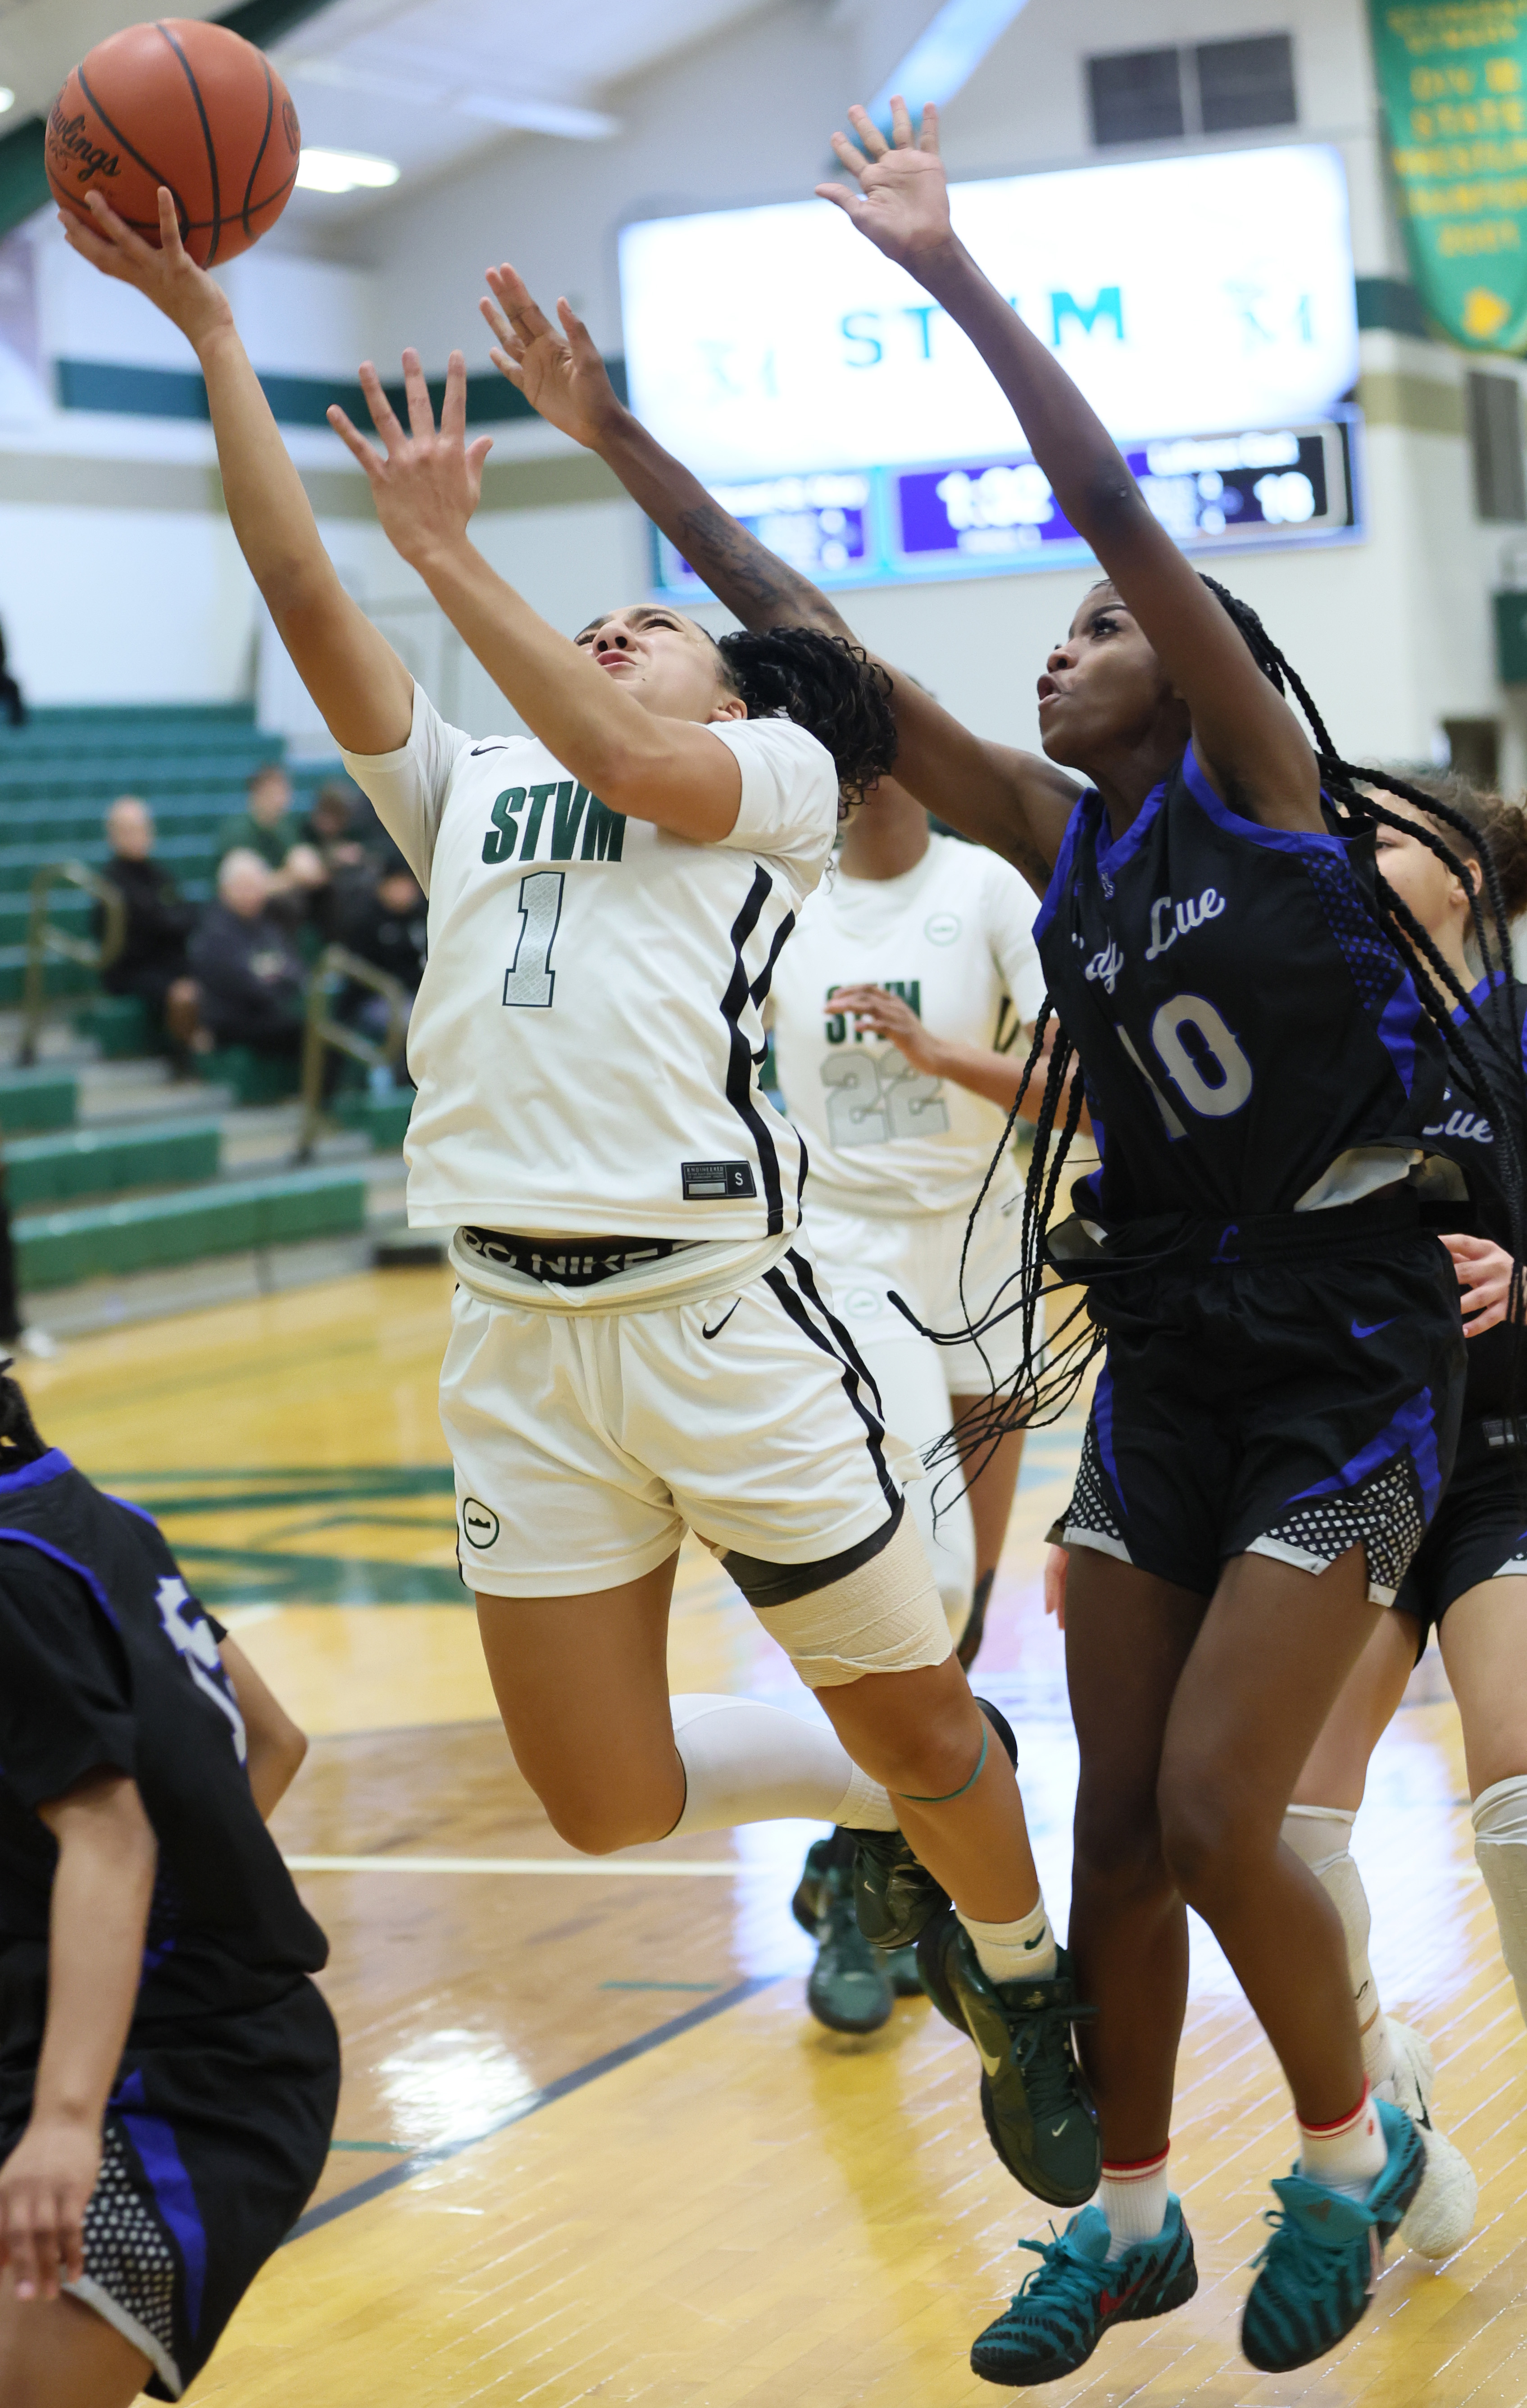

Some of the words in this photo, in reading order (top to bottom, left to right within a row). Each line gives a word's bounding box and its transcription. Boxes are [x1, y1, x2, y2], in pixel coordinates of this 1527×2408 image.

[47, 81, 121, 182] wlings
[841, 286, 1124, 368] STM
[482, 781, 627, 864] STVM
[502, 871, 565, 1008] 1
[1145, 888, 1226, 961] Lue
[826, 979, 921, 1044] SM
[820, 1048, 950, 1148] 22
[735, 1172, 743, 1186] S
